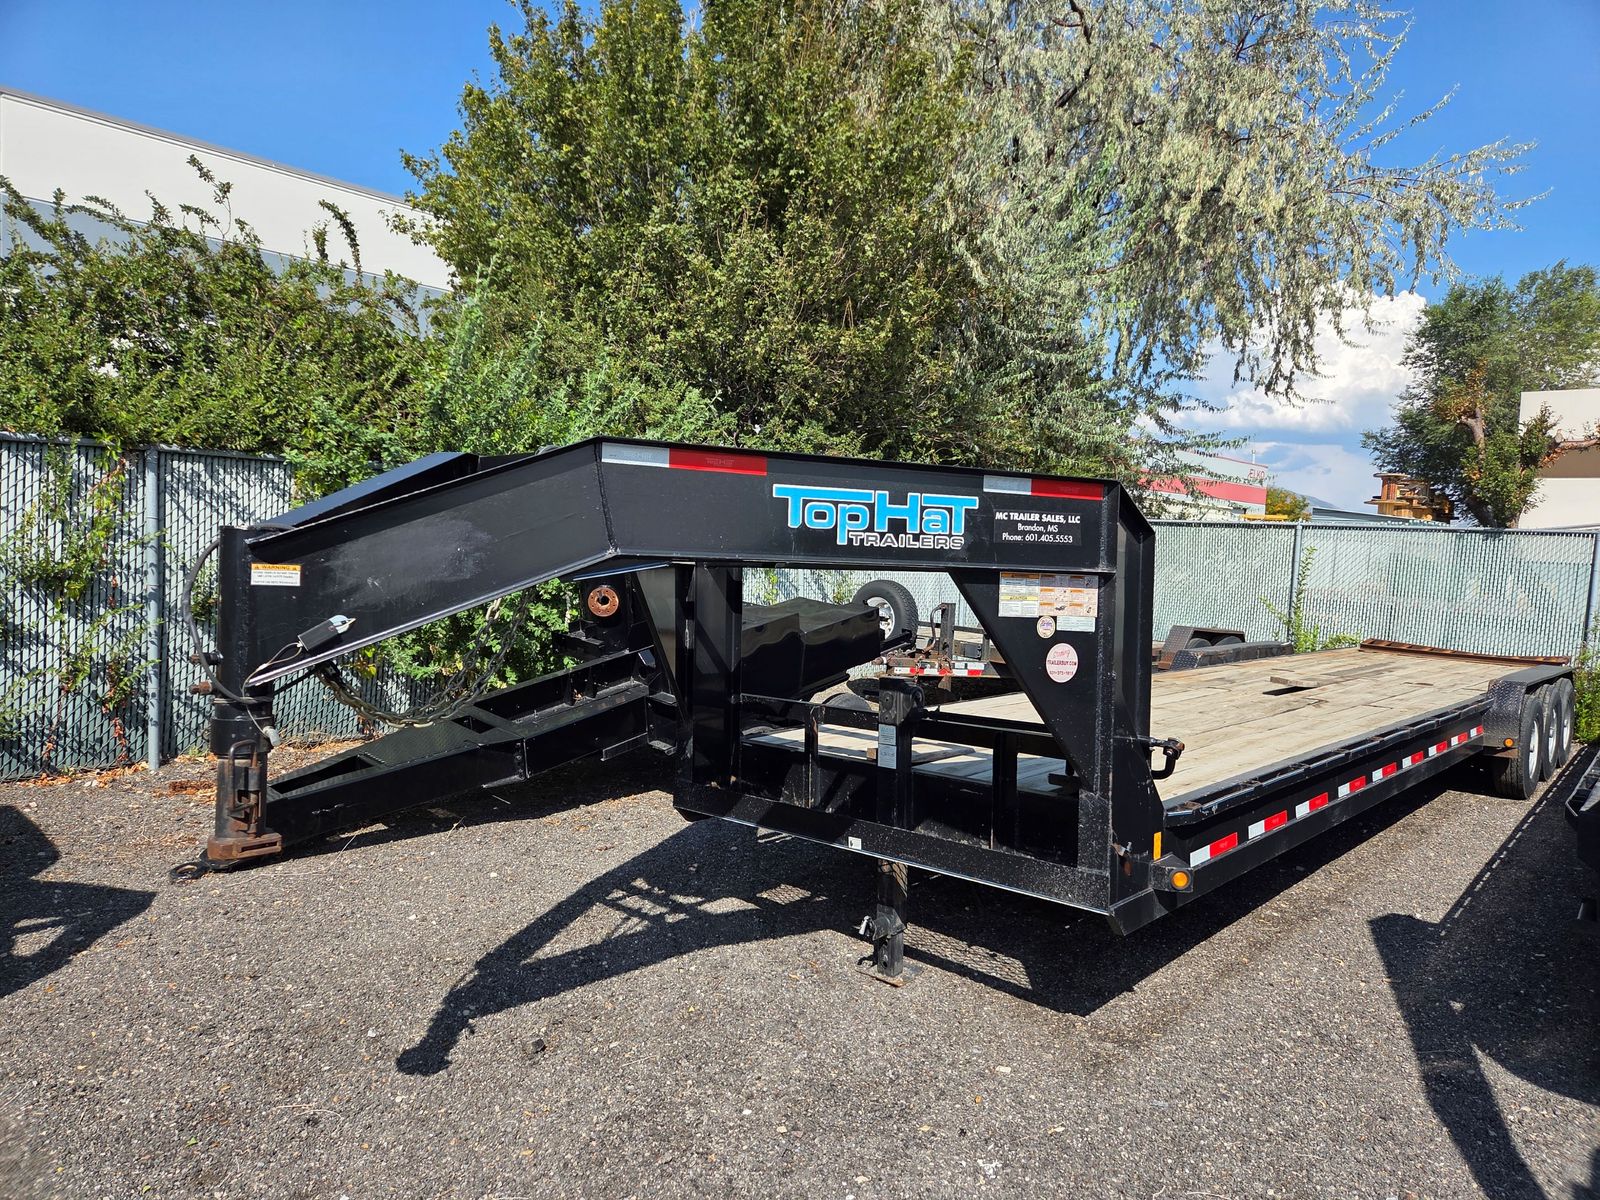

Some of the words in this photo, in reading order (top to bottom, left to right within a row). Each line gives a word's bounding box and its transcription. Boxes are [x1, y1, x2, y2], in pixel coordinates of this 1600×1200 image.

[995, 512, 1008, 520] MC
[1009, 512, 1040, 521] TRAILER
[1041, 514, 1066, 524] SALES,
[1068, 515, 1081, 524] LLC
[1017, 523, 1046, 533] Brandon,
[1047, 524, 1059, 532] MS
[849, 532, 965, 549] TRAILERS
[1002, 532, 1024, 541] Phone:
[1025, 533, 1073, 543] 601.405.5553
